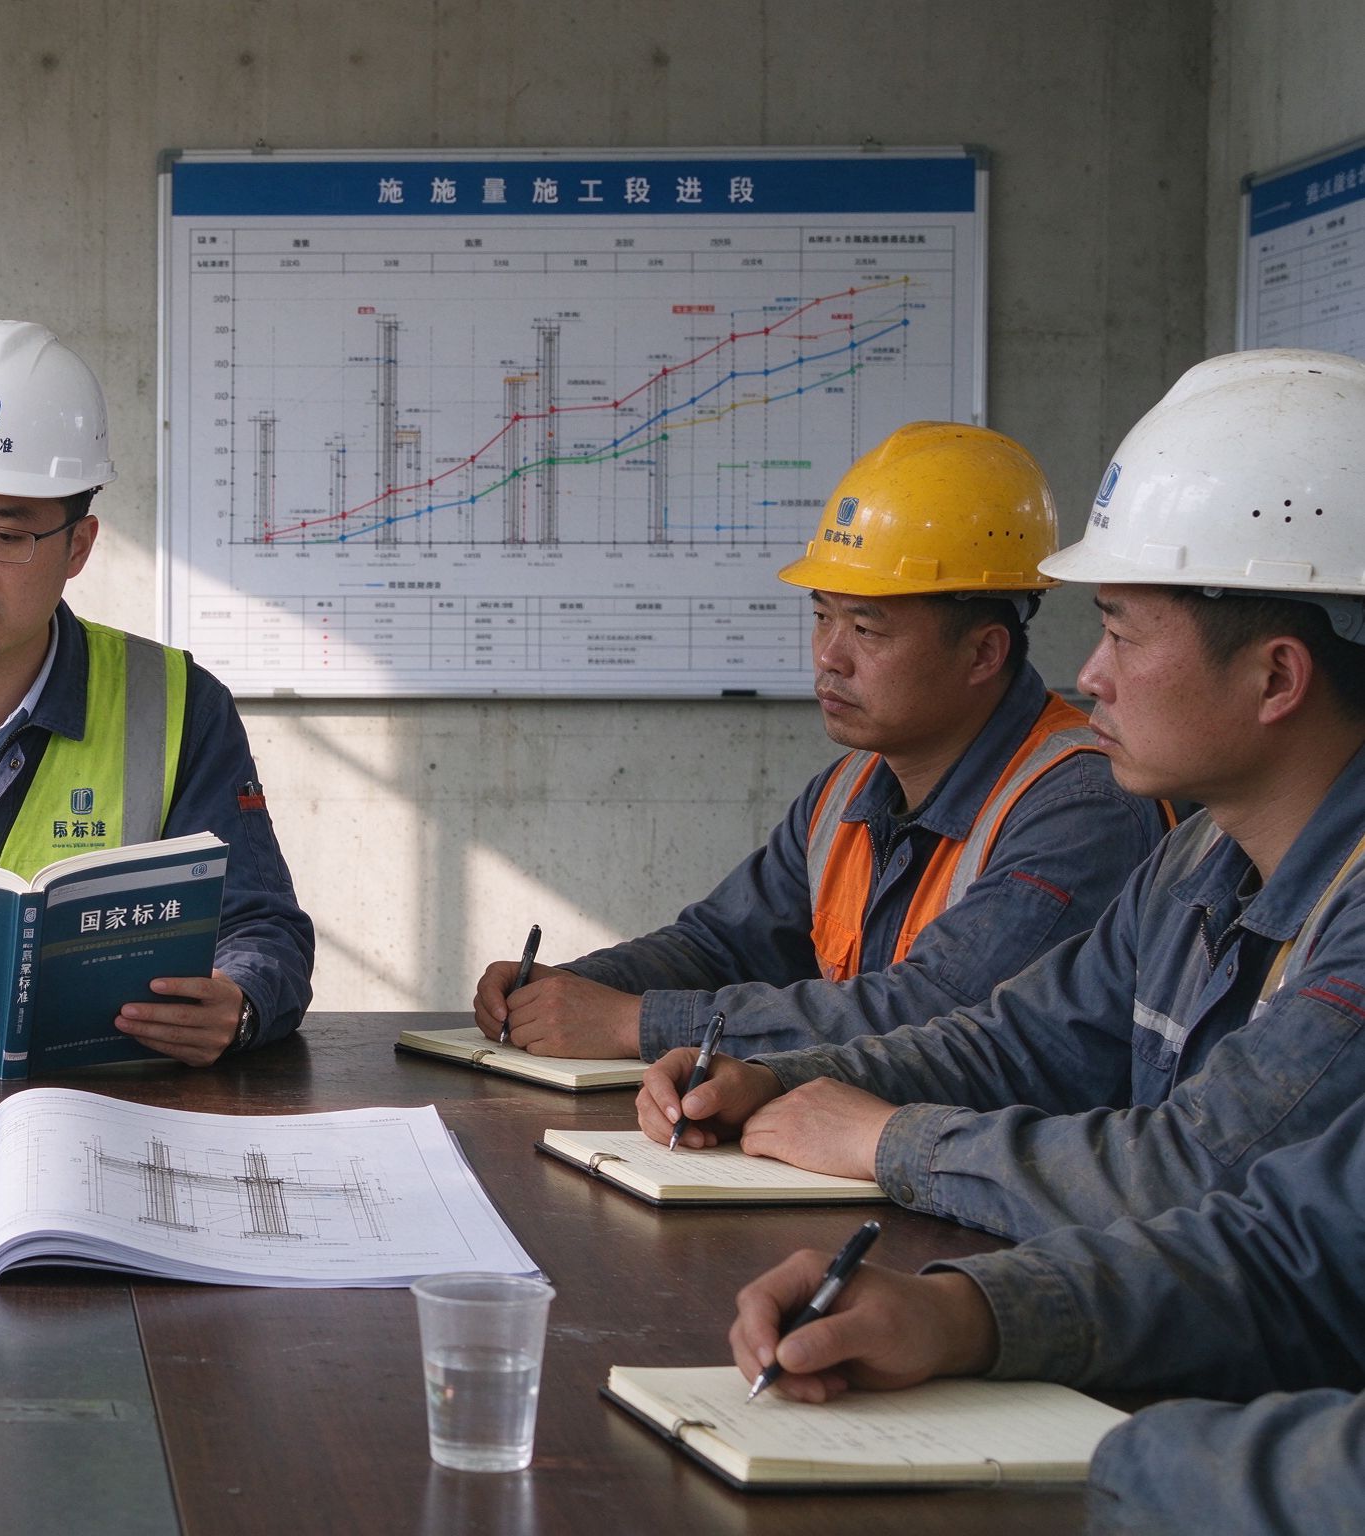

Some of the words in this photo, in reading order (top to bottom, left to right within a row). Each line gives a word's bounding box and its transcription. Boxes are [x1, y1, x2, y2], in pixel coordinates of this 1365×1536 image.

[378, 177, 754, 203] 施施量施工段进段
[80, 899, 182, 933] 国家标准
